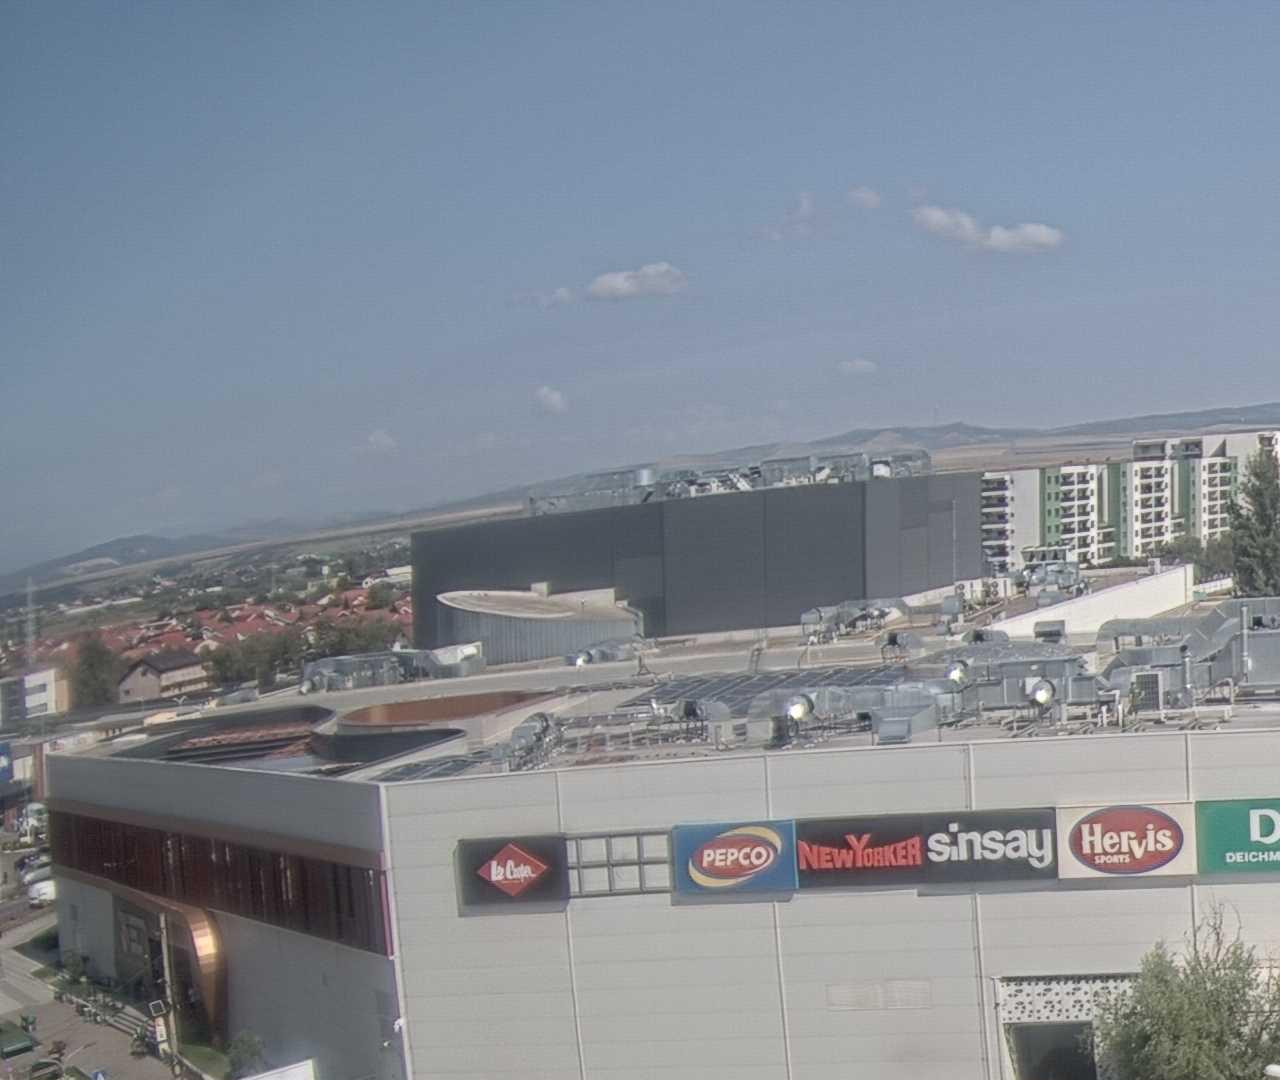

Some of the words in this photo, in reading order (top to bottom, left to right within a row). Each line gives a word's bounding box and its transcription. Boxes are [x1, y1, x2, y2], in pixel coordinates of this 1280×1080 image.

[927, 823, 1052, 868] sinsay
[1081, 823, 1174, 859] Hervis
[702, 848, 767, 868] PEPCO
[1094, 855, 1130, 864] SPORTS
